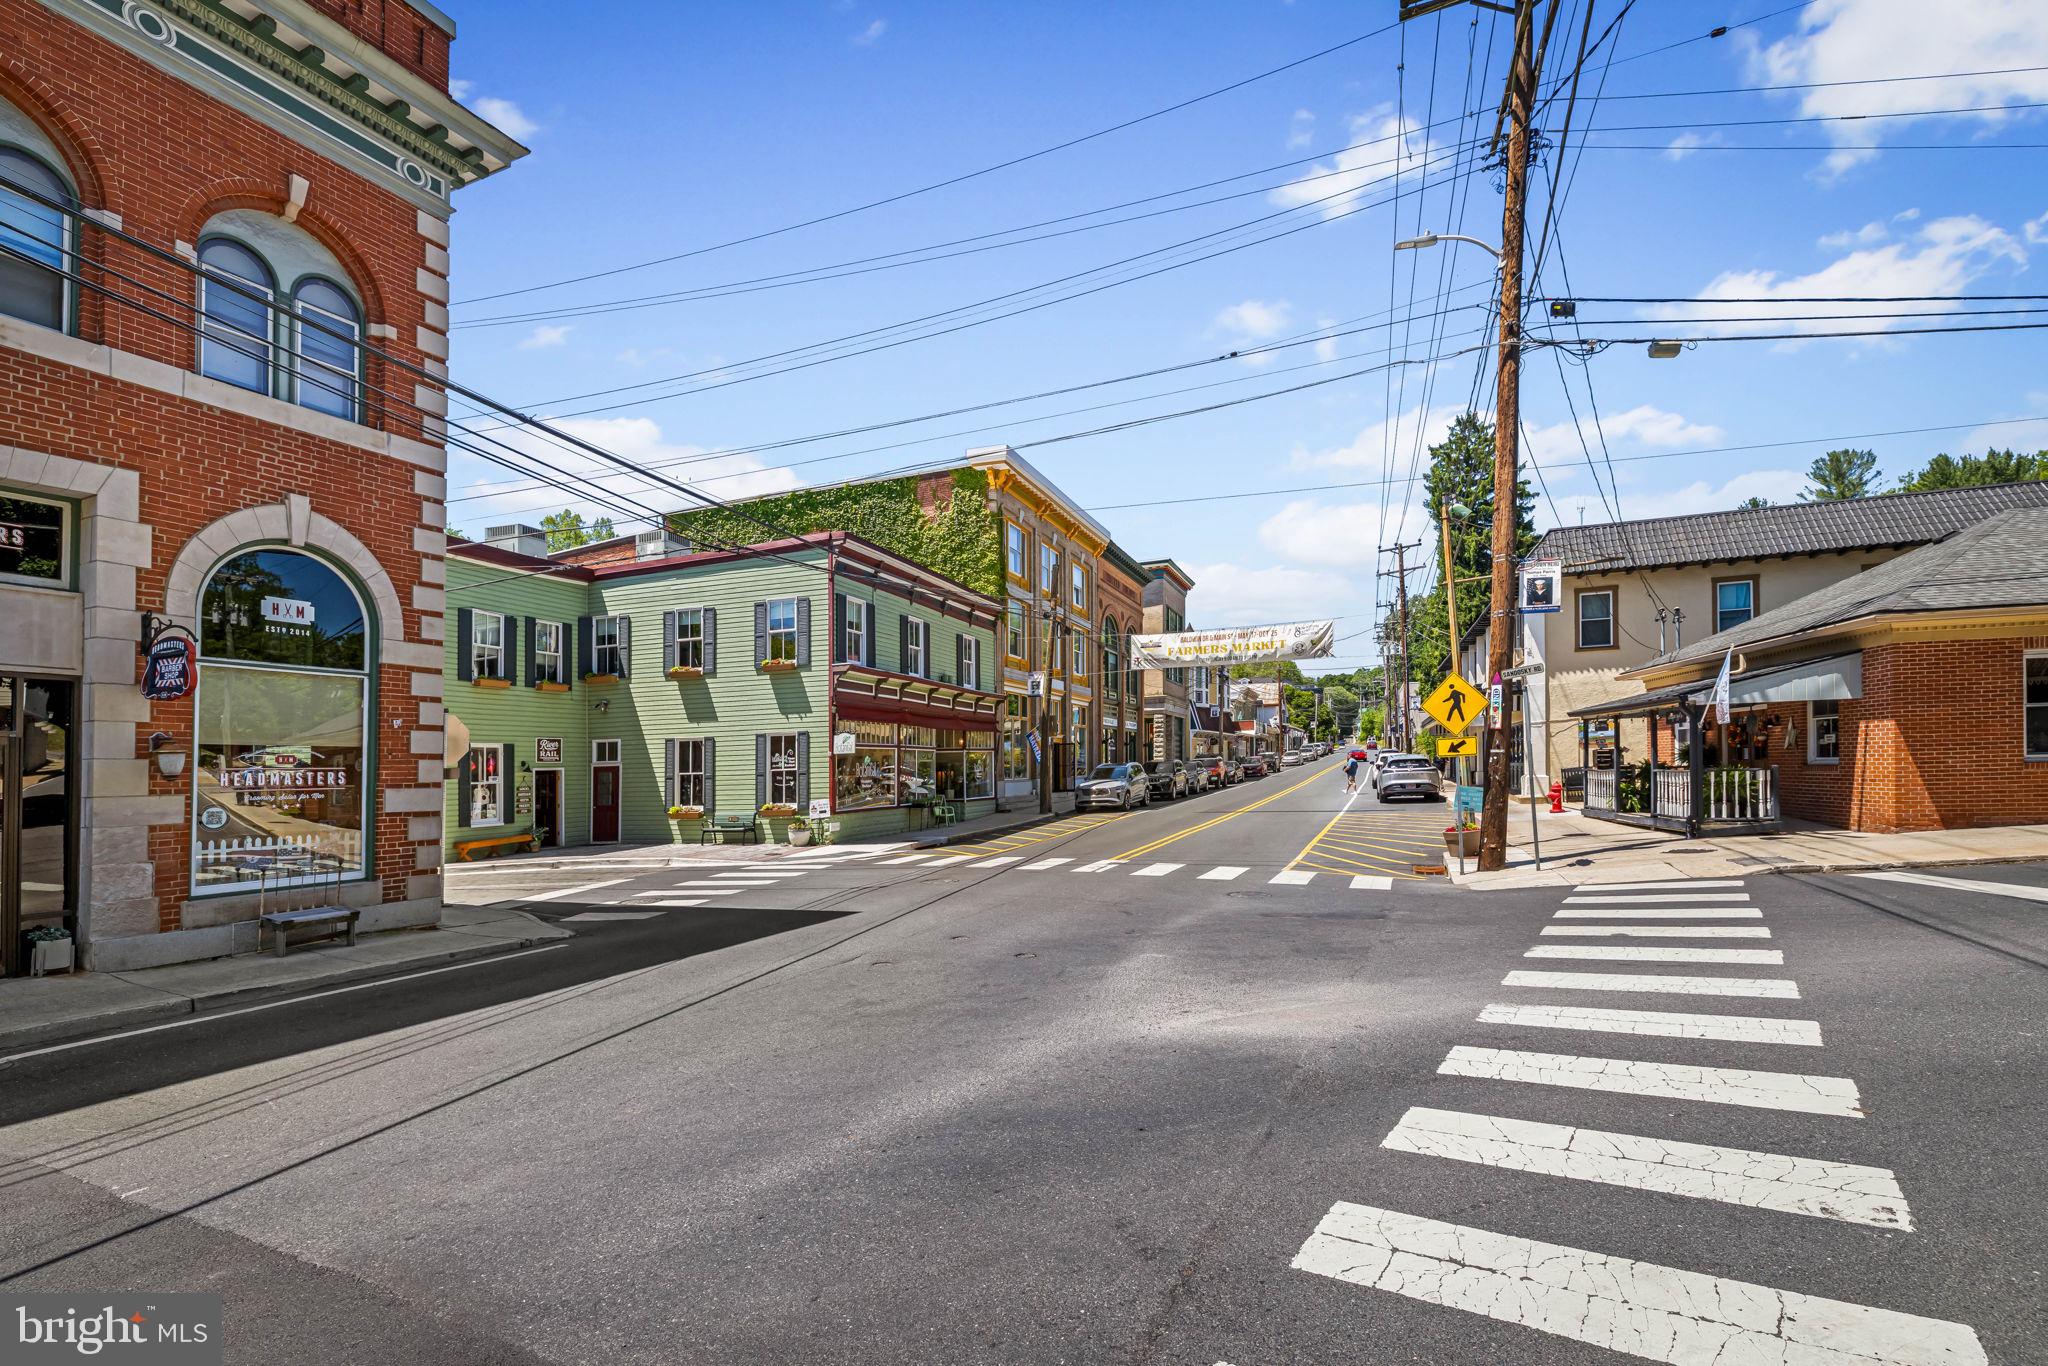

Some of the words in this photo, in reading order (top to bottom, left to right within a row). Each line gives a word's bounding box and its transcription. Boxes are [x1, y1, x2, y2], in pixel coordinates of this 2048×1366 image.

[290, 628, 310, 637] 2014
[1167, 643, 1228, 657] FARMERS
[1231, 639, 1287, 653] MARKET
[161, 663, 183, 673] BARBER
[164, 671, 179, 680] SHOP
[220, 771, 347, 787] HEADMASTERS
